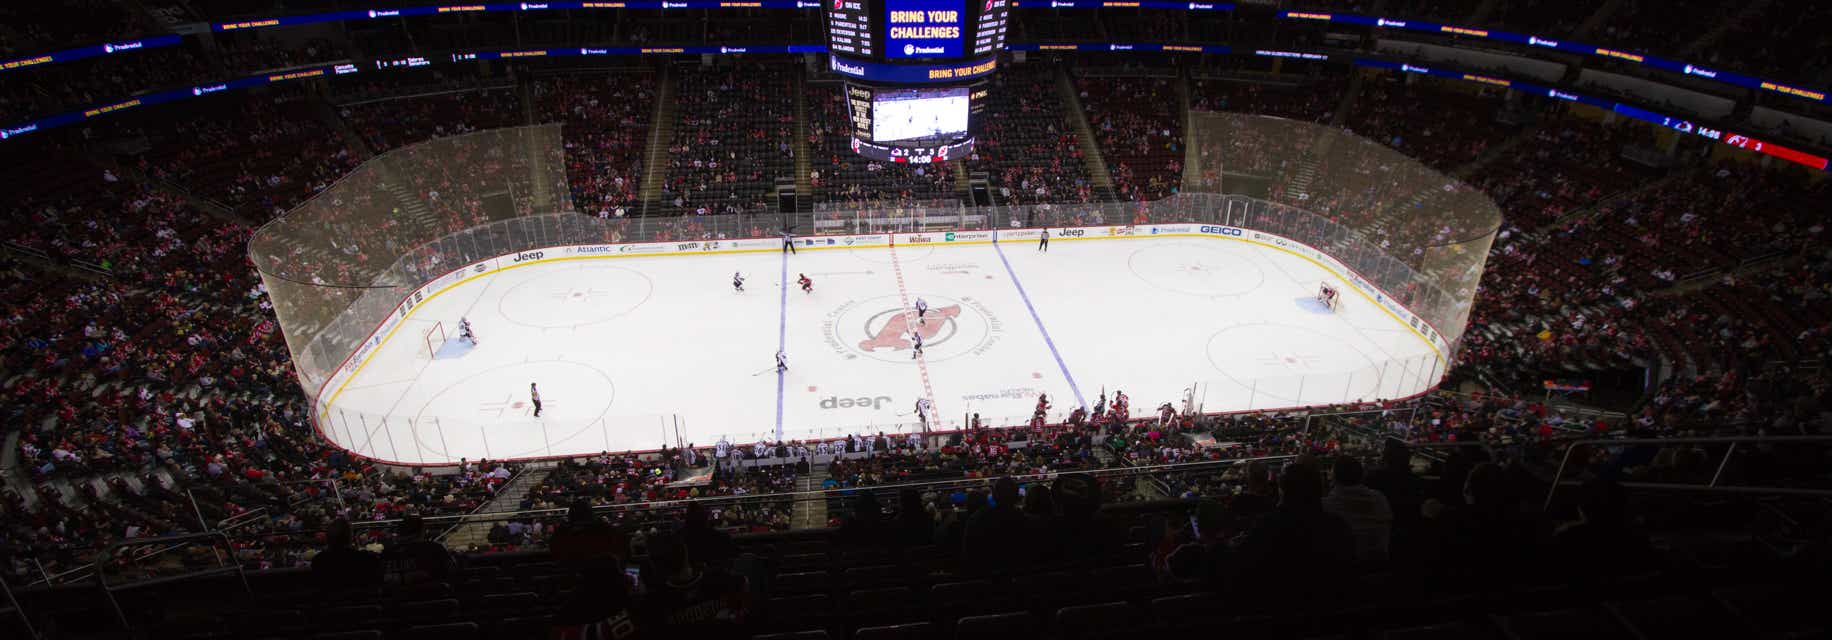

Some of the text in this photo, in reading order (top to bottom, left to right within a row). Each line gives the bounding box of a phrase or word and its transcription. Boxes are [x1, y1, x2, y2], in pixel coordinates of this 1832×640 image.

[891, 10, 958, 23] BRING YOUR
[251, 19, 279, 27] CHALLENGES
[890, 26, 960, 39] CHALLENGES
[114, 41, 142, 51] Prudential
[915, 46, 945, 54] Prudential
[837, 61, 865, 76] Prudential
[929, 69, 953, 79] BRING
[954, 66, 972, 77] YOUR
[849, 86, 871, 99] Jeep
[1791, 88, 1824, 100] CHALLENGES
[1755, 142, 1762, 151] 3
[904, 149, 909, 157] 2
[909, 155, 932, 164] 14:06
[1059, 227, 1085, 237] Jeep
[1200, 225, 1242, 236] GEICO
[577, 245, 610, 254] Atlantic
[513, 250, 544, 262] Jeep
[820, 396, 892, 410] Jeep
